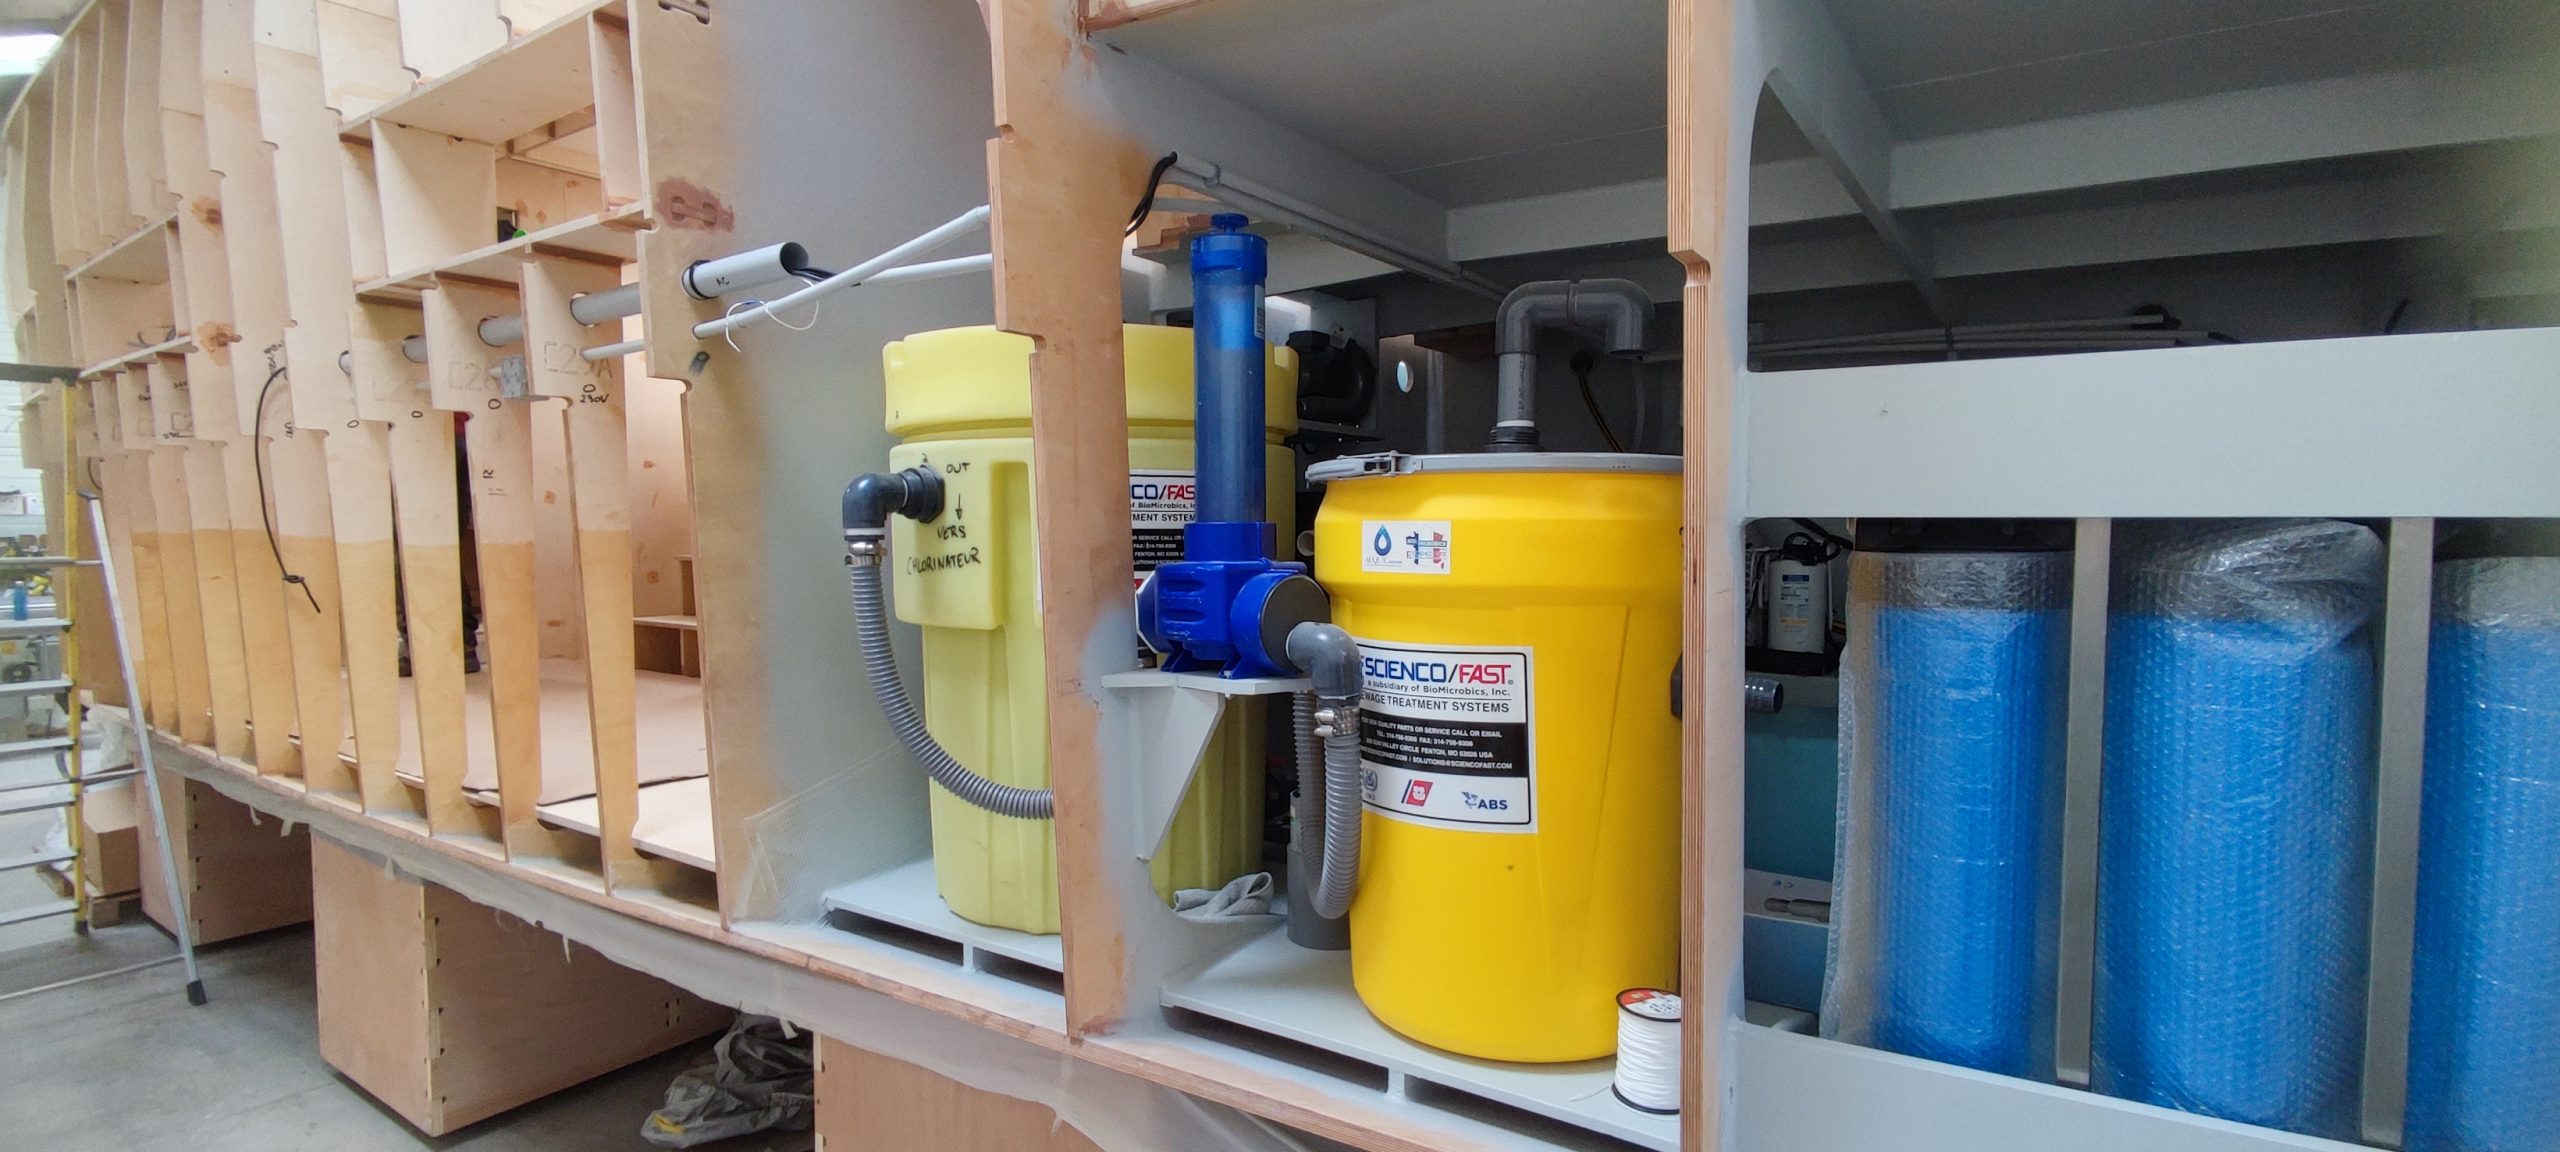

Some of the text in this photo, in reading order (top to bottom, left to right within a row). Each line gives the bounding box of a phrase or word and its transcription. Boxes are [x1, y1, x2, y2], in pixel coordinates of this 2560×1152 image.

[946, 462, 970, 474] OUT
[937, 525, 966, 540] VERS
[907, 547, 981, 575] CHLORINATEUR
[1373, 680, 1408, 692] subsidiary
[1411, 684, 1420, 692] of
[1423, 686, 1489, 697] BioMicrobics,
[1492, 688, 1511, 696] Inc.
[1388, 695, 1448, 711] TREATMENT
[1452, 701, 1510, 713] SYSTEMS
[1424, 726, 1450, 735] SERVICE
[1400, 744, 1419, 753] CIRCLE
[1478, 800, 1508, 810] ABS
